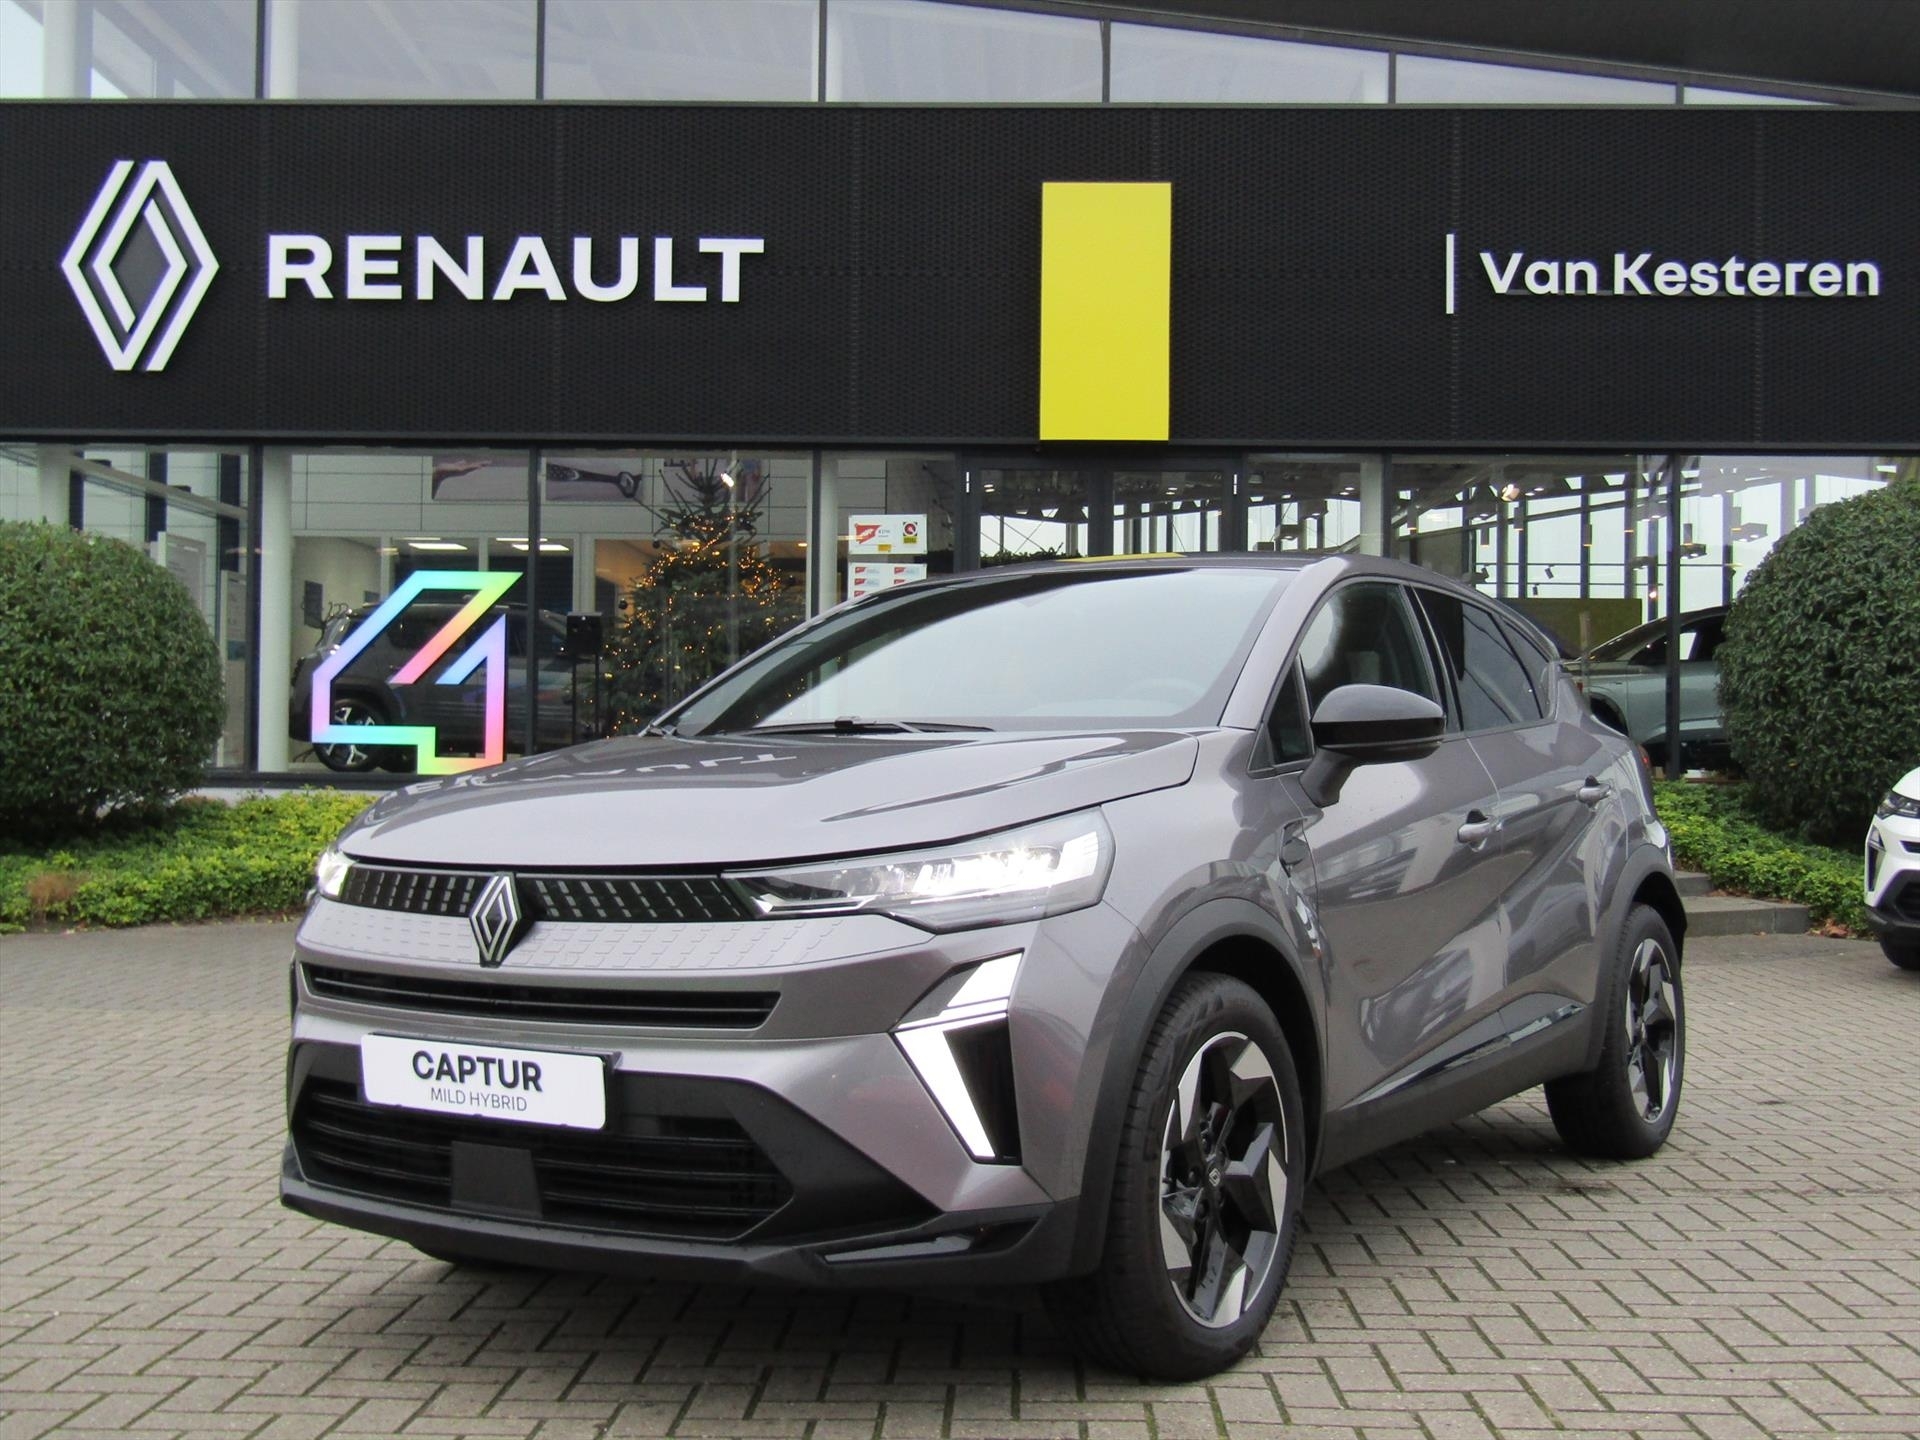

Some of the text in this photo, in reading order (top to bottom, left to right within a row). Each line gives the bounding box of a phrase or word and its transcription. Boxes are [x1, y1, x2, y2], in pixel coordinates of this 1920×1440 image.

[267, 234, 766, 303] RENAULT
[1479, 252, 1880, 297] Van Kesteren
[412, 1050, 543, 1092] CAPTUR
[431, 1087, 528, 1112] MILD HYBRID
